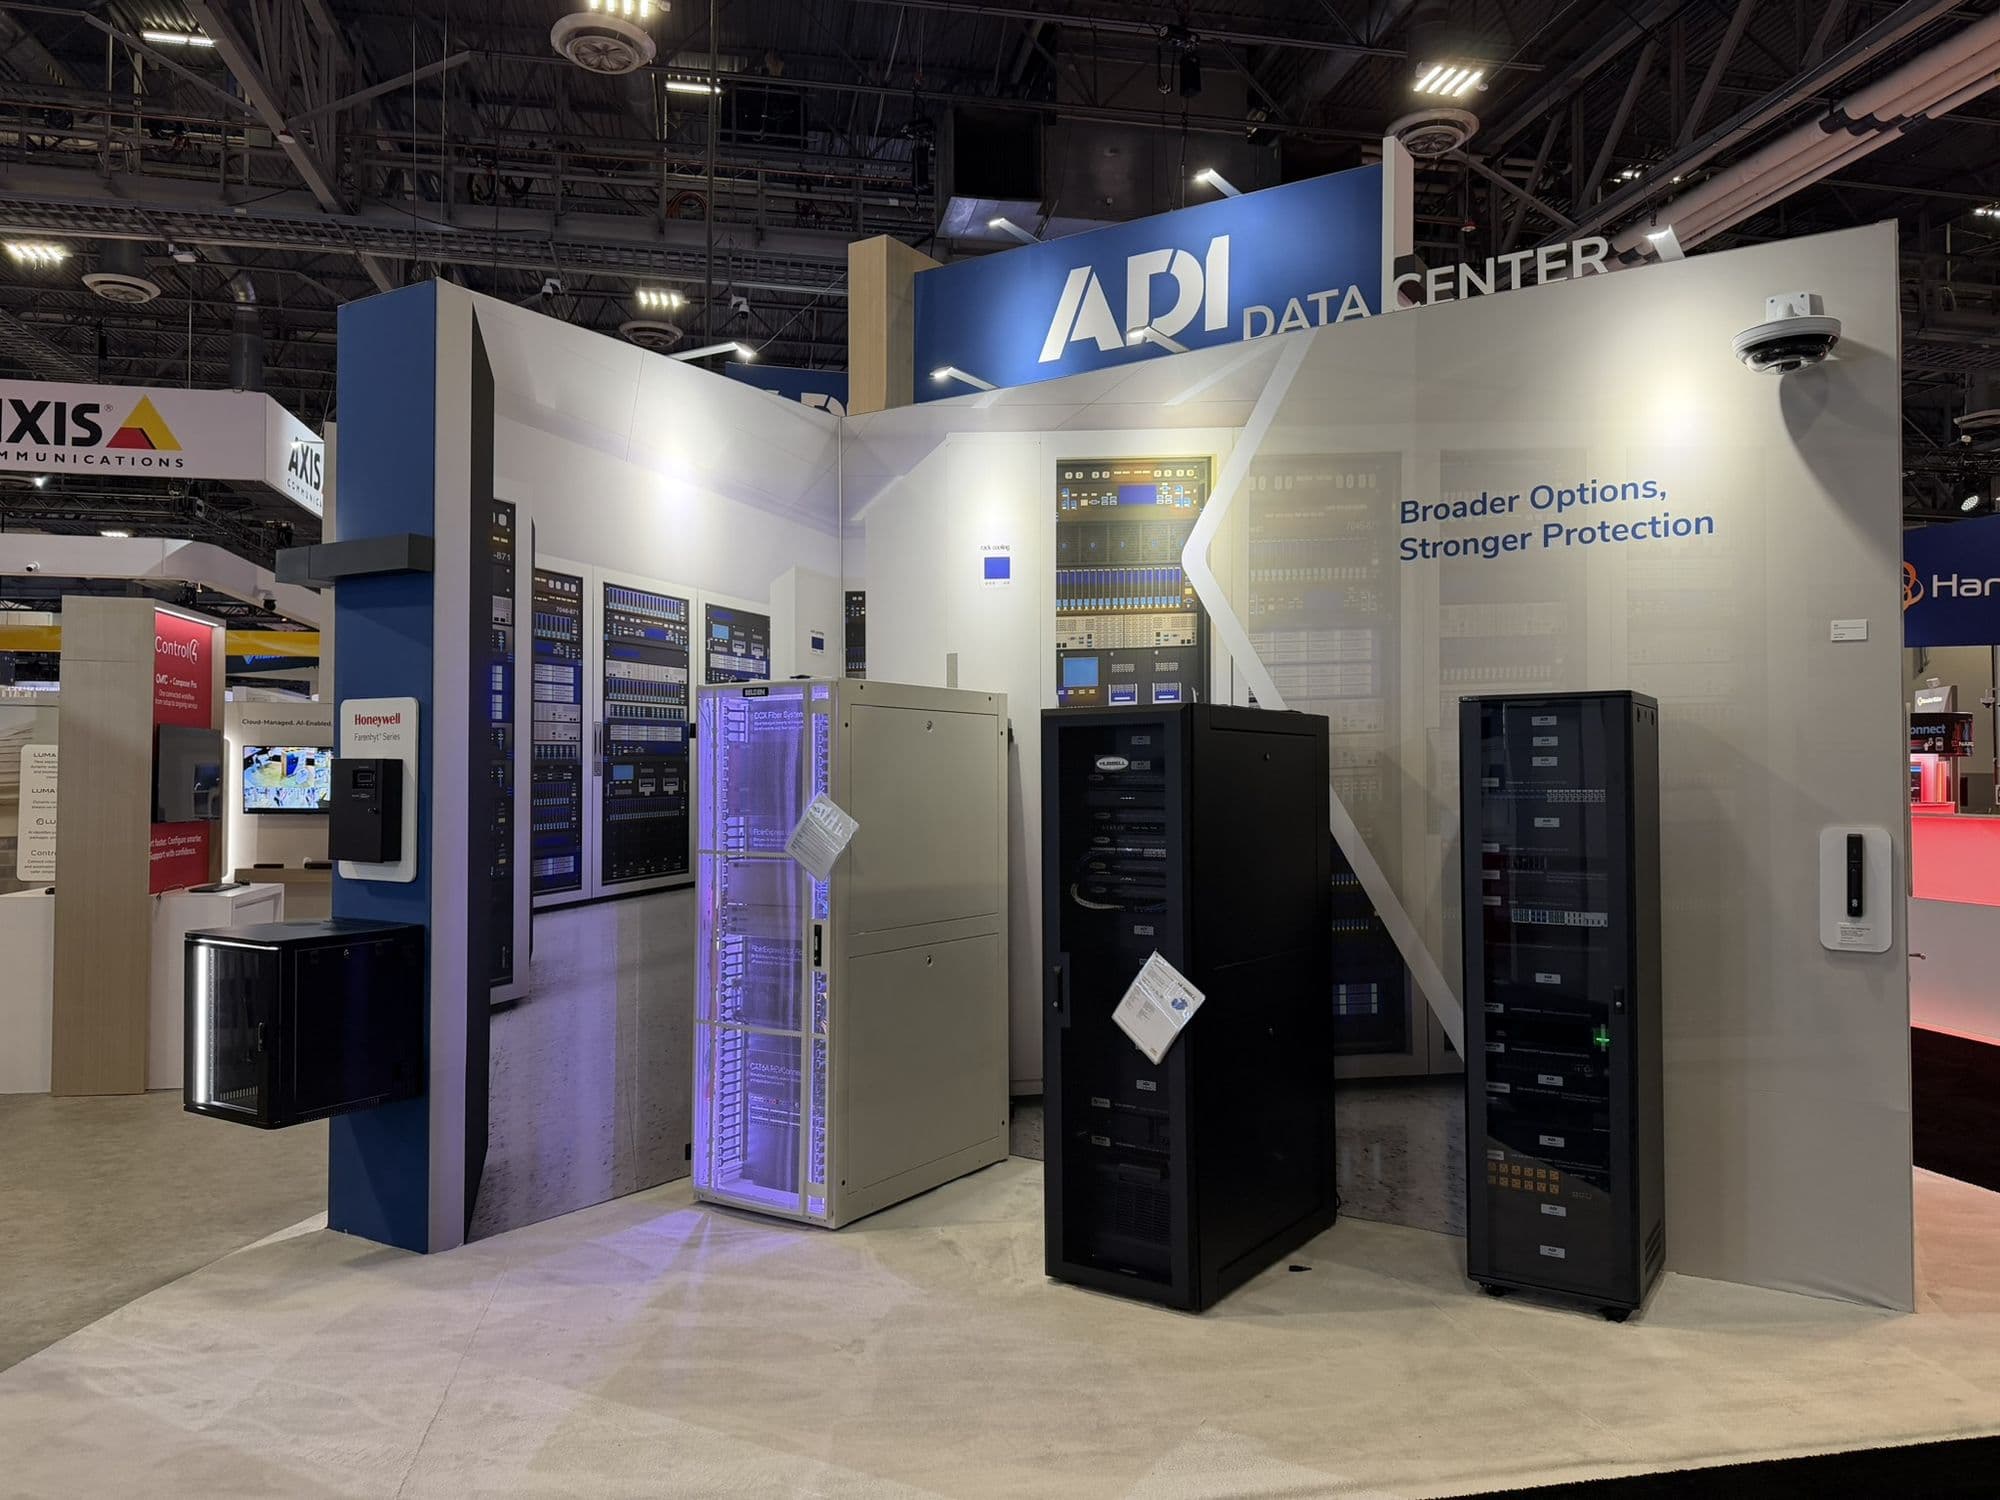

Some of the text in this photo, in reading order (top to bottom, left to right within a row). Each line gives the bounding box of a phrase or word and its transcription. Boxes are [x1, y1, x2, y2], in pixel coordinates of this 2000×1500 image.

[1038, 234, 1230, 363] ADI
[1242, 236, 1609, 341] DATA CENTER
[288, 443, 322, 491] AXIS
[1400, 479, 1667, 524] Broader Options,
[1400, 512, 1714, 561] Stronger Protection
[354, 713, 401, 727] Honeywell
